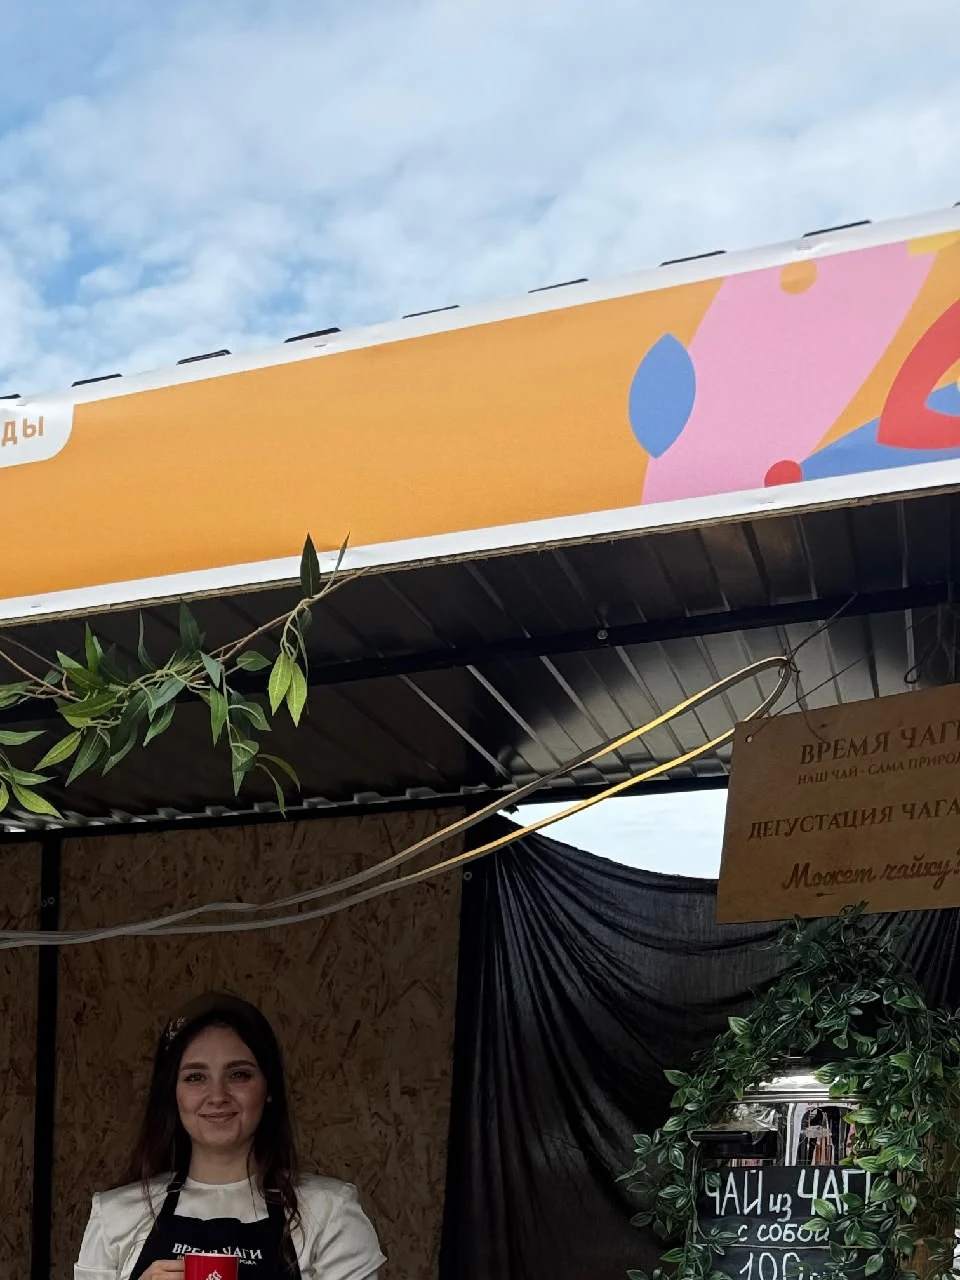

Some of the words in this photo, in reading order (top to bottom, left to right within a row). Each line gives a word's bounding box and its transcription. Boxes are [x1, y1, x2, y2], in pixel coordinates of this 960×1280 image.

[800, 731, 891, 765] ВРЕМЯ
[749, 806, 895, 841] ДЕГУСТАЦИЯ
[782, 862, 876, 890] Может
[704, 1169, 763, 1216] ЧАЙ
